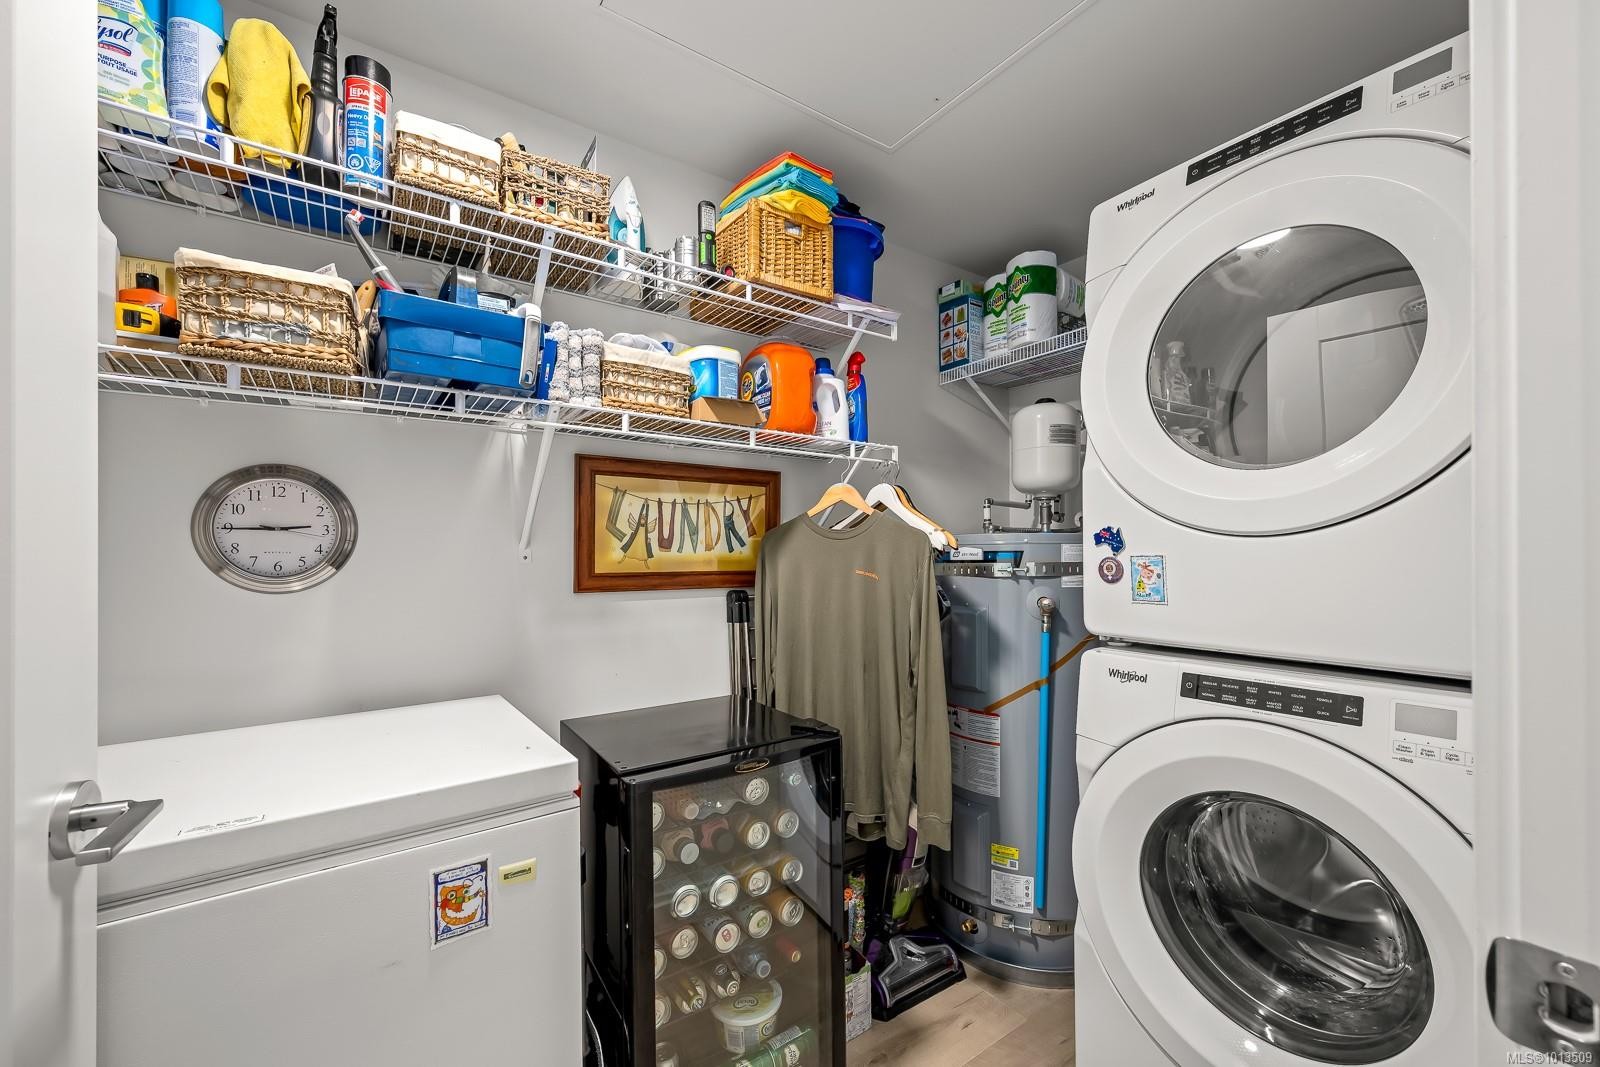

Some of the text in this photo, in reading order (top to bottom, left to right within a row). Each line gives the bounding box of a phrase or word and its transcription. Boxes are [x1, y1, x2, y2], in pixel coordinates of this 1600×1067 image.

[97, 19, 134, 42] ysol
[97, 58, 116, 70] TOUT
[116, 64, 138, 78] USAGE
[1116, 188, 1155, 212] Whirlpool
[1007, 273, 1031, 297] Bounty
[986, 290, 1007, 310] Bount
[248, 490, 262, 502] 11
[271, 486, 286, 498] 12
[301, 492, 305, 503] 1
[231, 503, 245, 515] 10
[316, 506, 325, 517] 2
[606, 486, 757, 558] LAUNDRY
[223, 522, 233, 535] 9
[322, 524, 330, 536] 3
[230, 542, 240, 555] 8
[314, 544, 323, 555] 4
[249, 556, 258, 568] 7
[273, 561, 282, 572] 6
[298, 556, 306, 568] 5
[1108, 668, 1148, 684] Whirlpool
